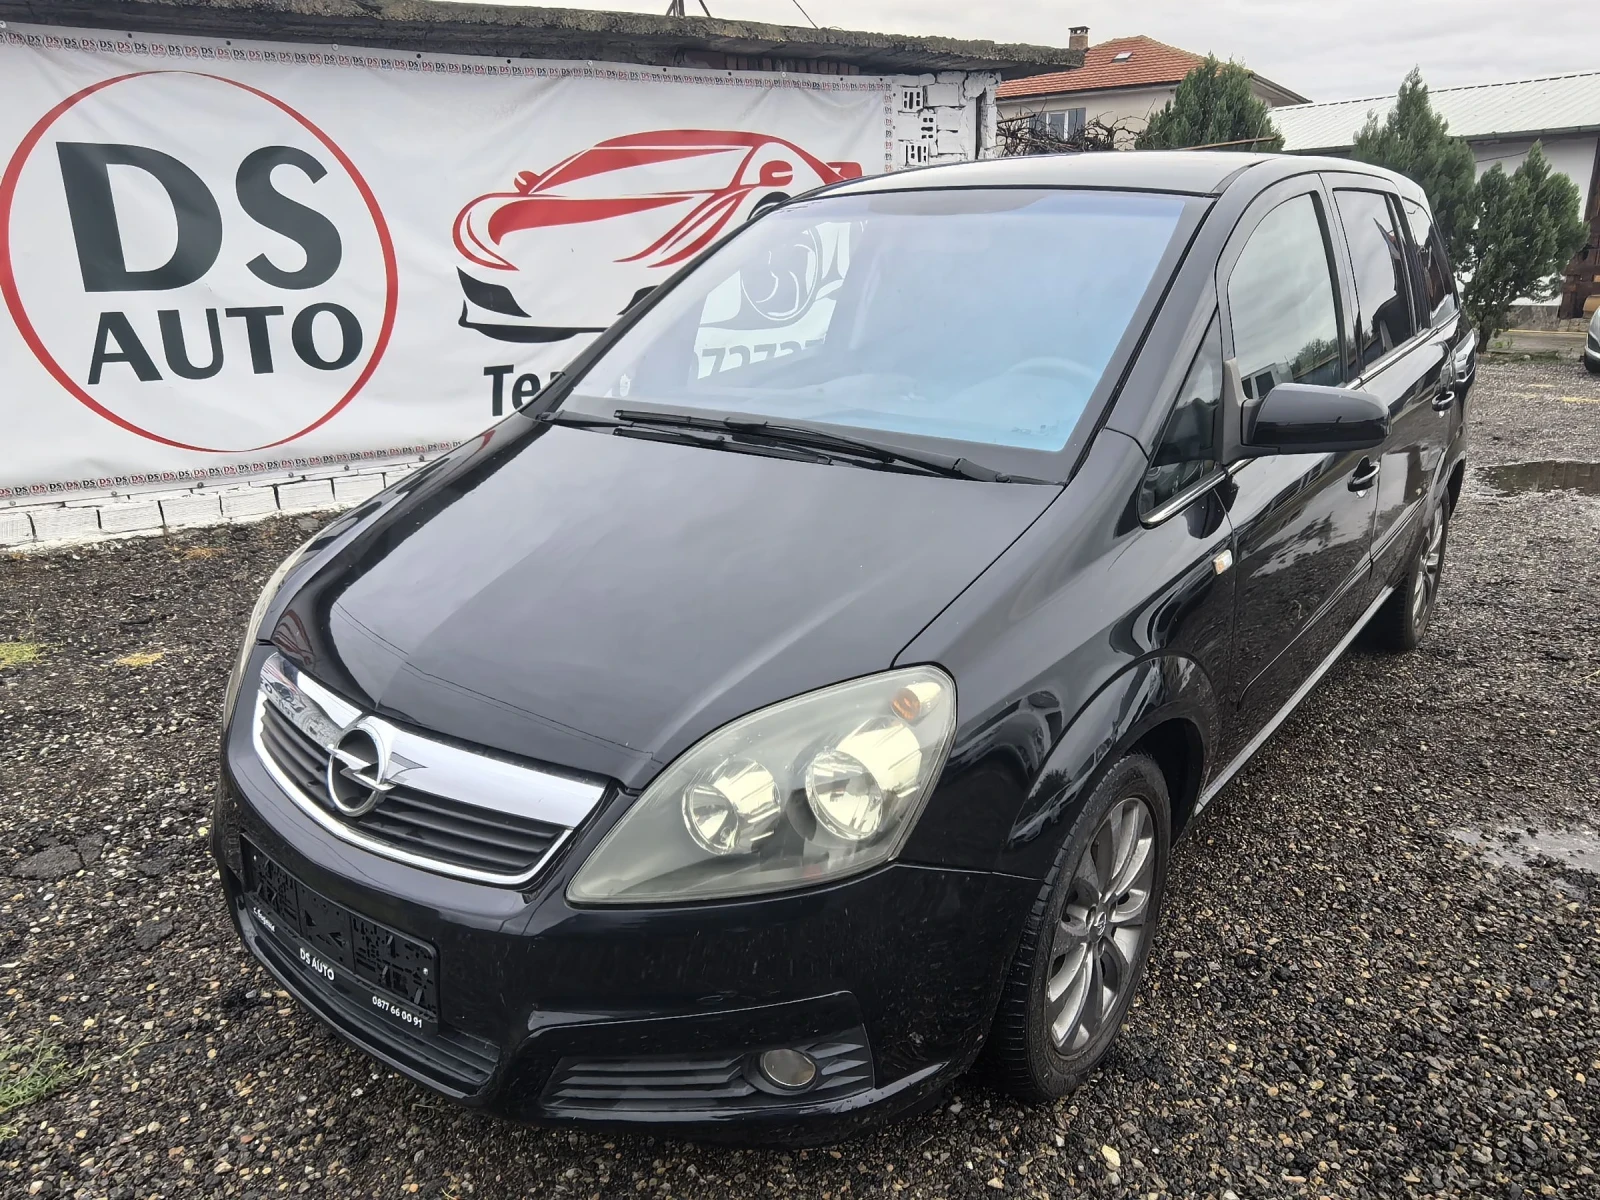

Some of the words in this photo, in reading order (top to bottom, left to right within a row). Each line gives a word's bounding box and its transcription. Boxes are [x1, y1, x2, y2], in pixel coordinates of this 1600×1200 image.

[56, 141, 342, 292] DS
[88, 302, 363, 385] AUTO
[300, 947, 311, 965] DS
[311, 956, 335, 981] AUTO
[372, 995, 390, 1011] 0877
[390, 1005, 401, 1017] 66
[401, 1010, 412, 1023] 00
[413, 1016, 423, 1029] 91
